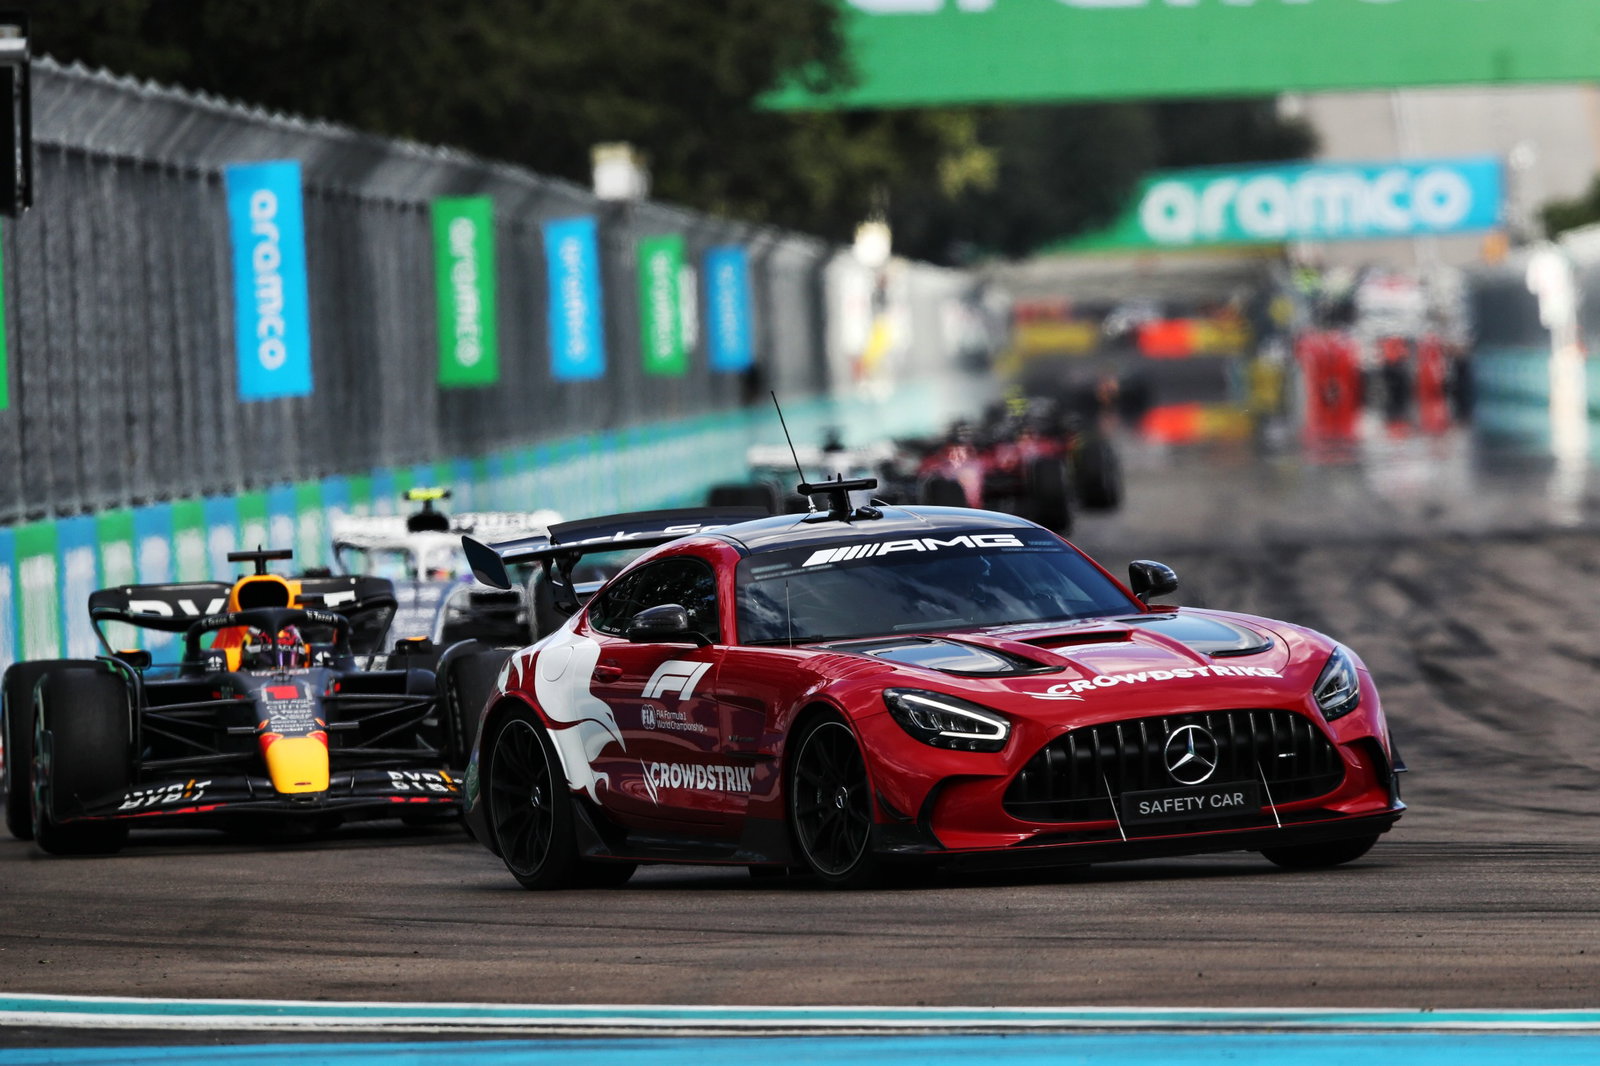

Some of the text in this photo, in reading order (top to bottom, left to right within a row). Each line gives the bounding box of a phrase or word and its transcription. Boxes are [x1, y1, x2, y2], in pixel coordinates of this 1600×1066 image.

[1139, 166, 1473, 246] aramco
[250, 188, 288, 371] aramco
[876, 534, 1025, 556] AMG
[641, 660, 715, 700] F1
[1047, 664, 1284, 697] CROWDSTRIKE
[657, 721, 704, 733] World Championship
[664, 711, 684, 720] Formula
[651, 762, 755, 792] CROWDSTRIK
[1139, 792, 1244, 815] SAFETY CAR
